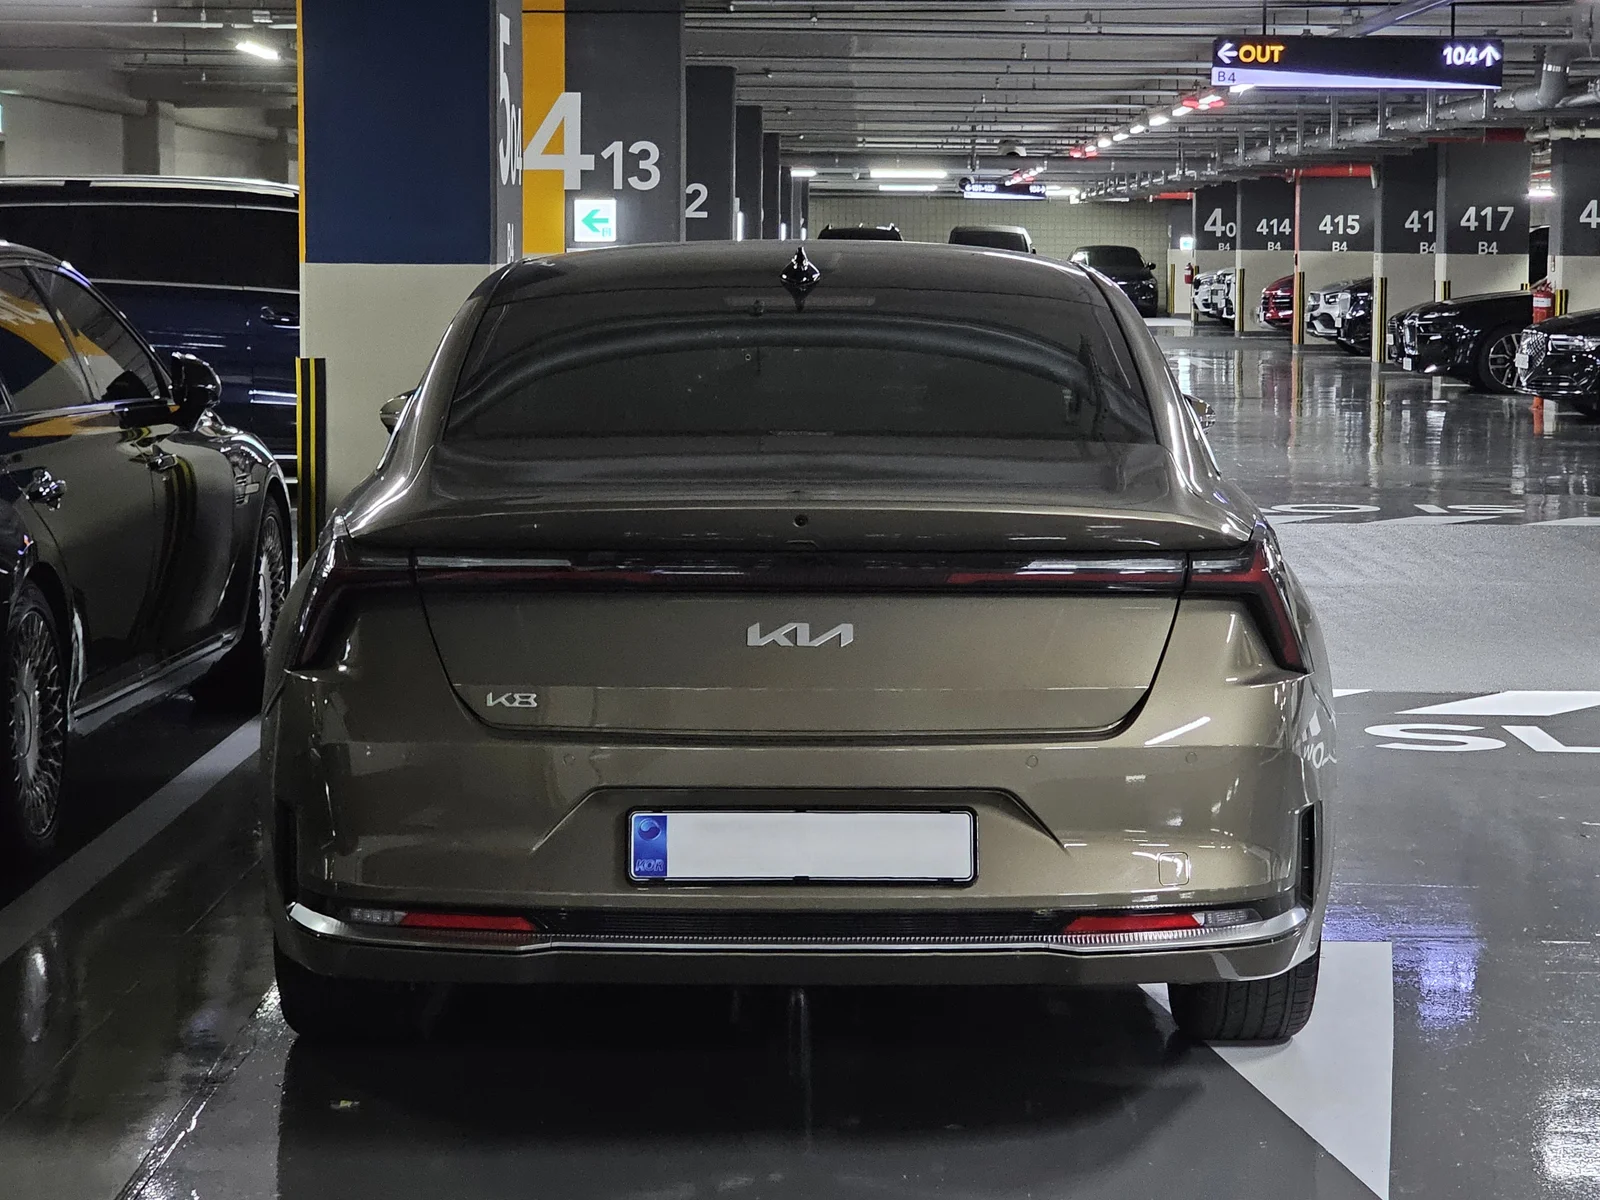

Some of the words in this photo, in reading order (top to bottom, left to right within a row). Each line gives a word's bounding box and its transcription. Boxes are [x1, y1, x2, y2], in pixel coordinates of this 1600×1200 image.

[1238, 45, 1285, 63] OUT
[1443, 46, 1478, 66] 104
[1256, 218, 1292, 236] 414
[1318, 214, 1361, 235] 415
[1460, 206, 1515, 232] 417
[1218, 242, 1231, 251] B4
[1267, 241, 1282, 251] B4
[1332, 241, 1348, 252] B4
[1478, 241, 1498, 255] B4
[747, 622, 855, 648] KIA
[486, 691, 538, 708] K8
[635, 858, 664, 872] KOR
